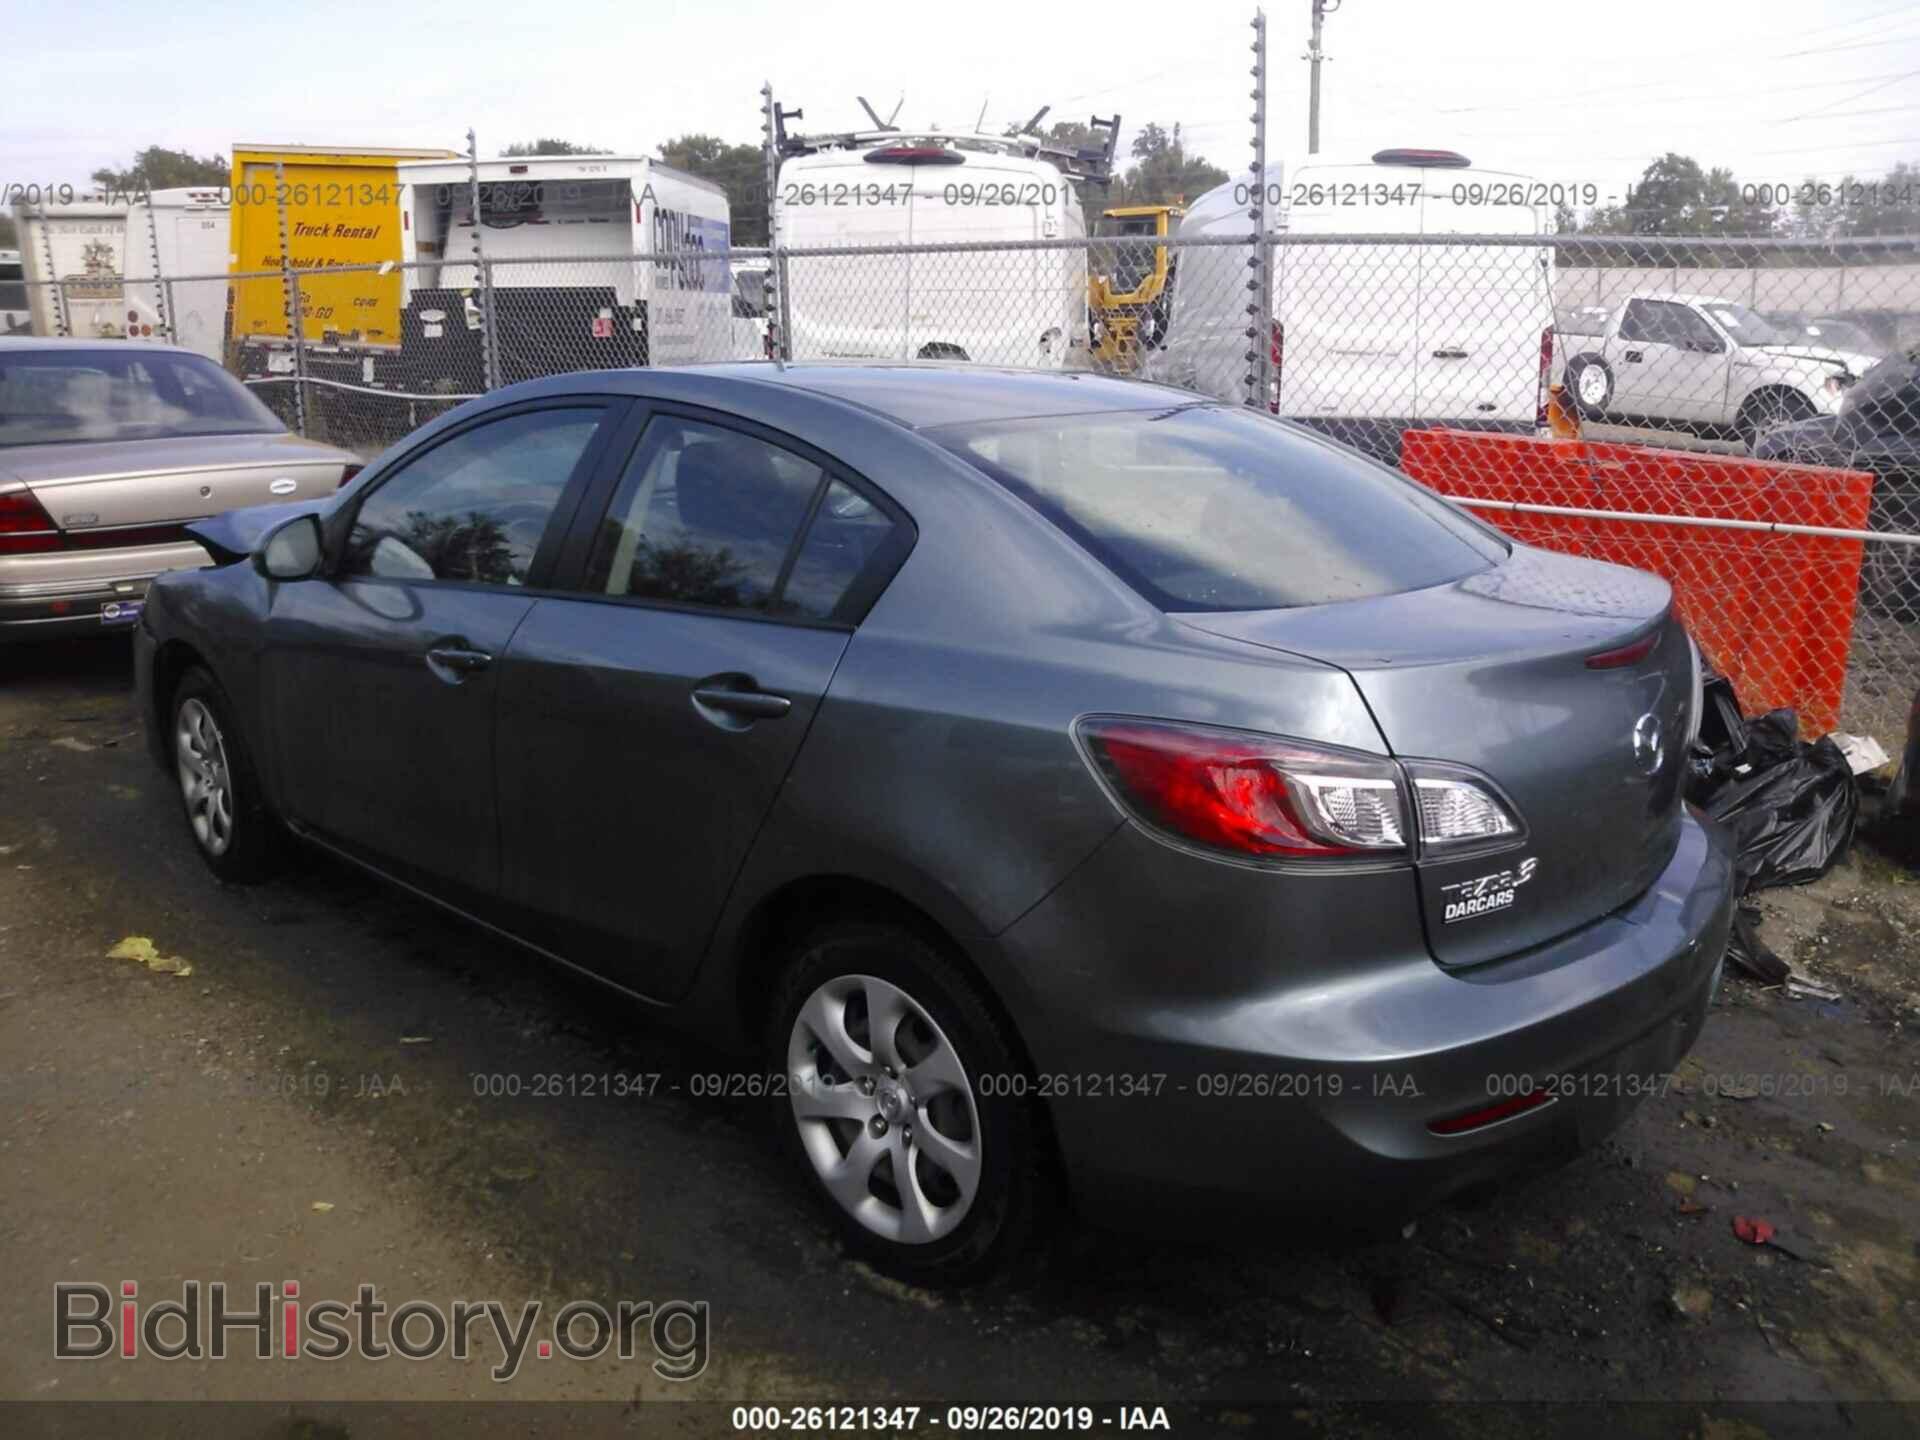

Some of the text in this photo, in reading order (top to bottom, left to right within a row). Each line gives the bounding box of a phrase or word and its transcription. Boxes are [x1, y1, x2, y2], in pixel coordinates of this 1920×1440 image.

[293, 222, 381, 240] Truck Rental
[1444, 889, 1514, 920] DARCARS
